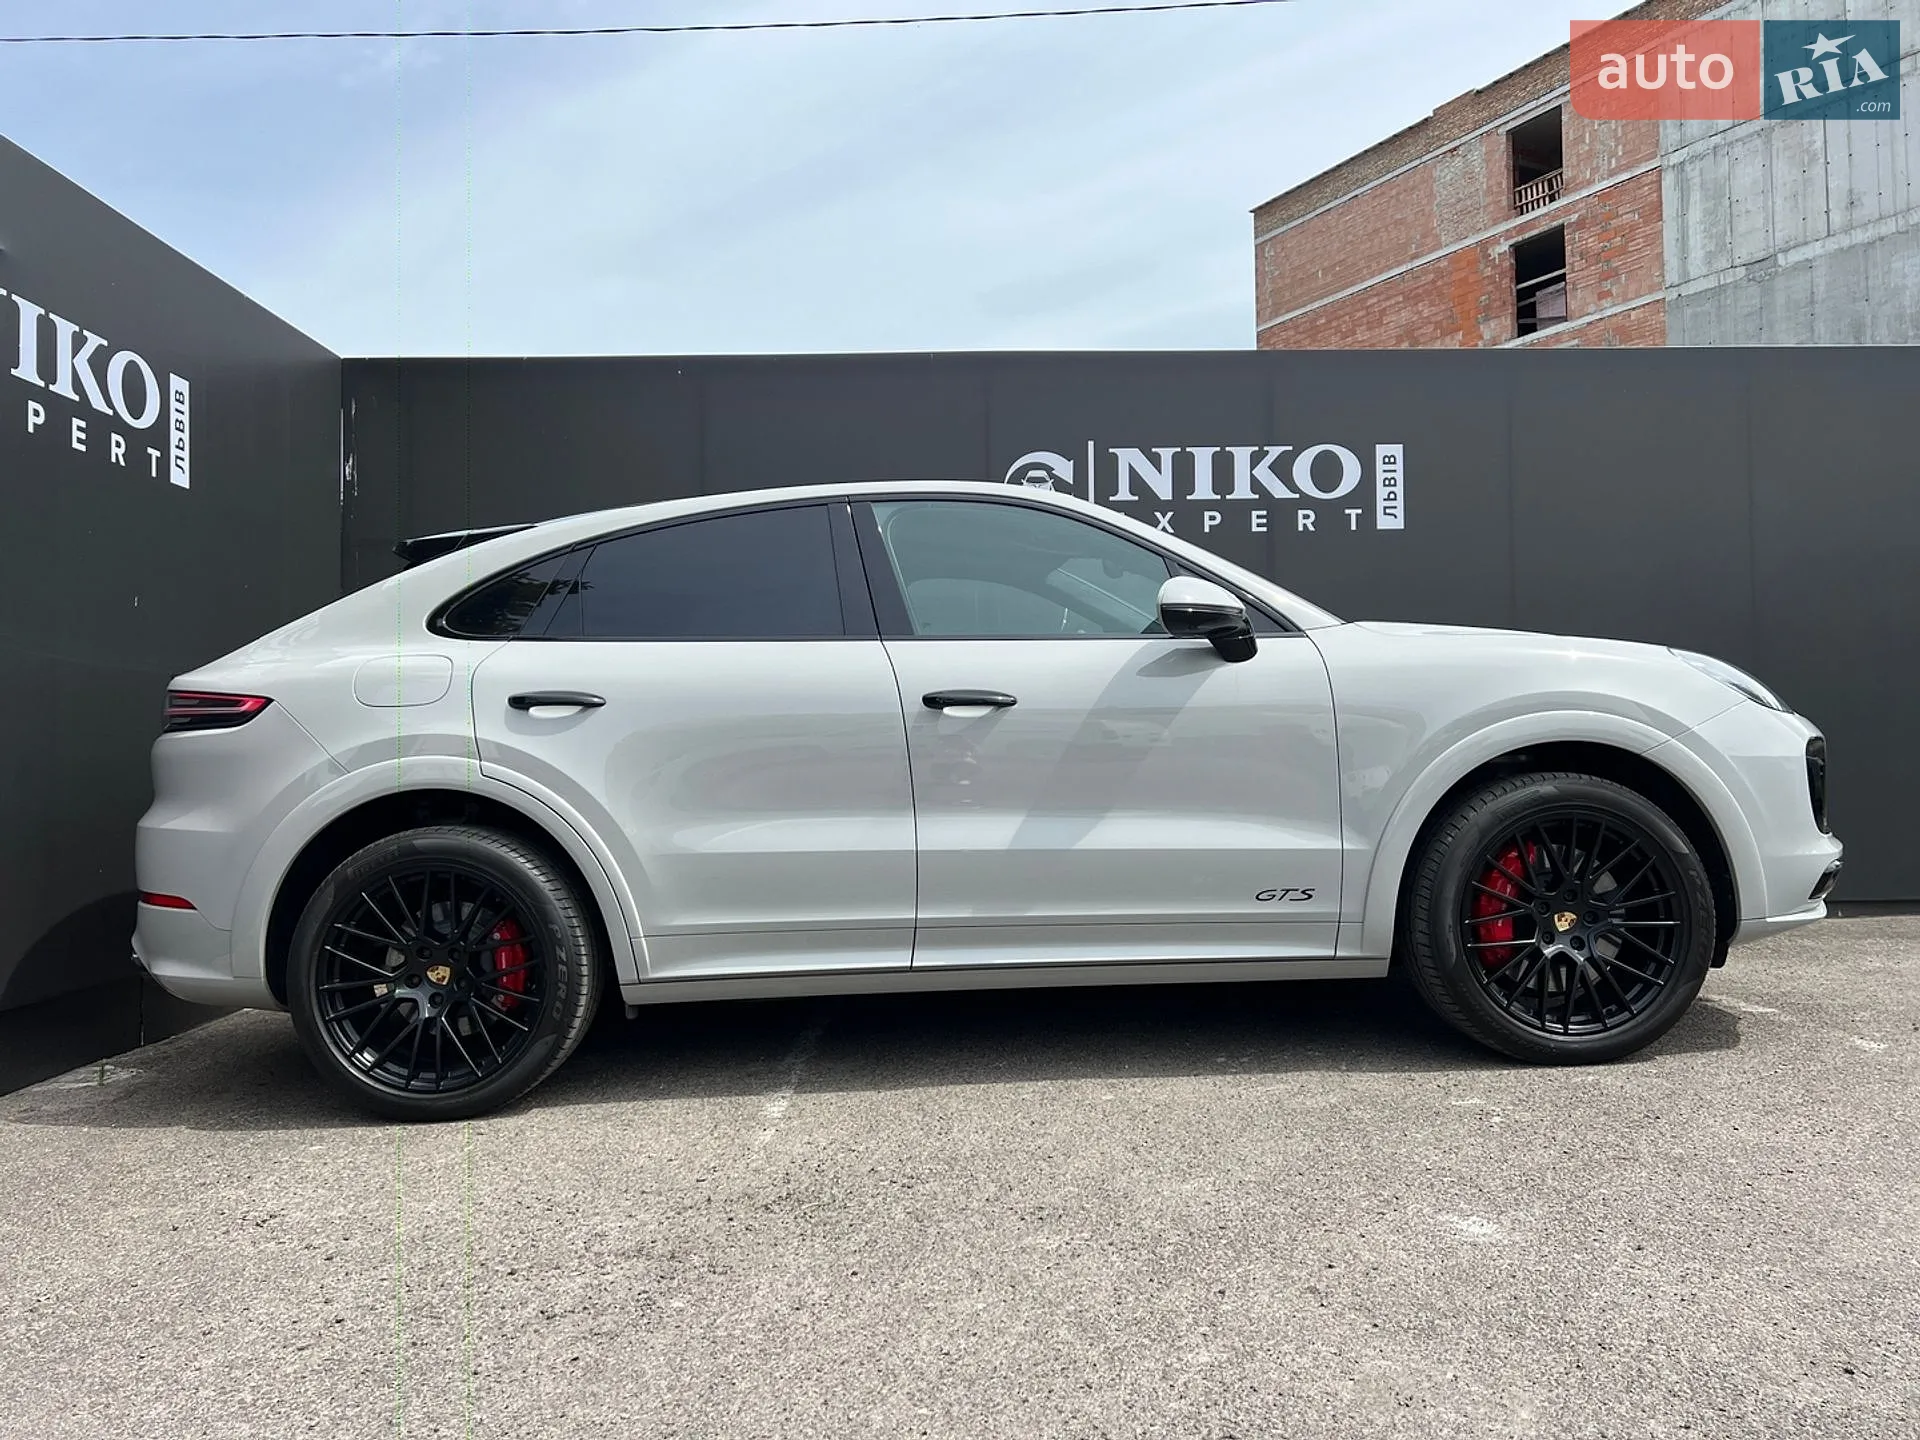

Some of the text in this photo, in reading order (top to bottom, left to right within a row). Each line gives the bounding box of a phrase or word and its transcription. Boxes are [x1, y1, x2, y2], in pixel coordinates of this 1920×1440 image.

[0, 287, 161, 430] IKO
[174, 388, 186, 475] ЛЬВІВ
[1108, 443, 1363, 501] NIKO
[1382, 454, 1398, 519] ЛЬВІВ
[1119, 508, 1363, 534] XPERT
[1255, 888, 1316, 902] GTS
